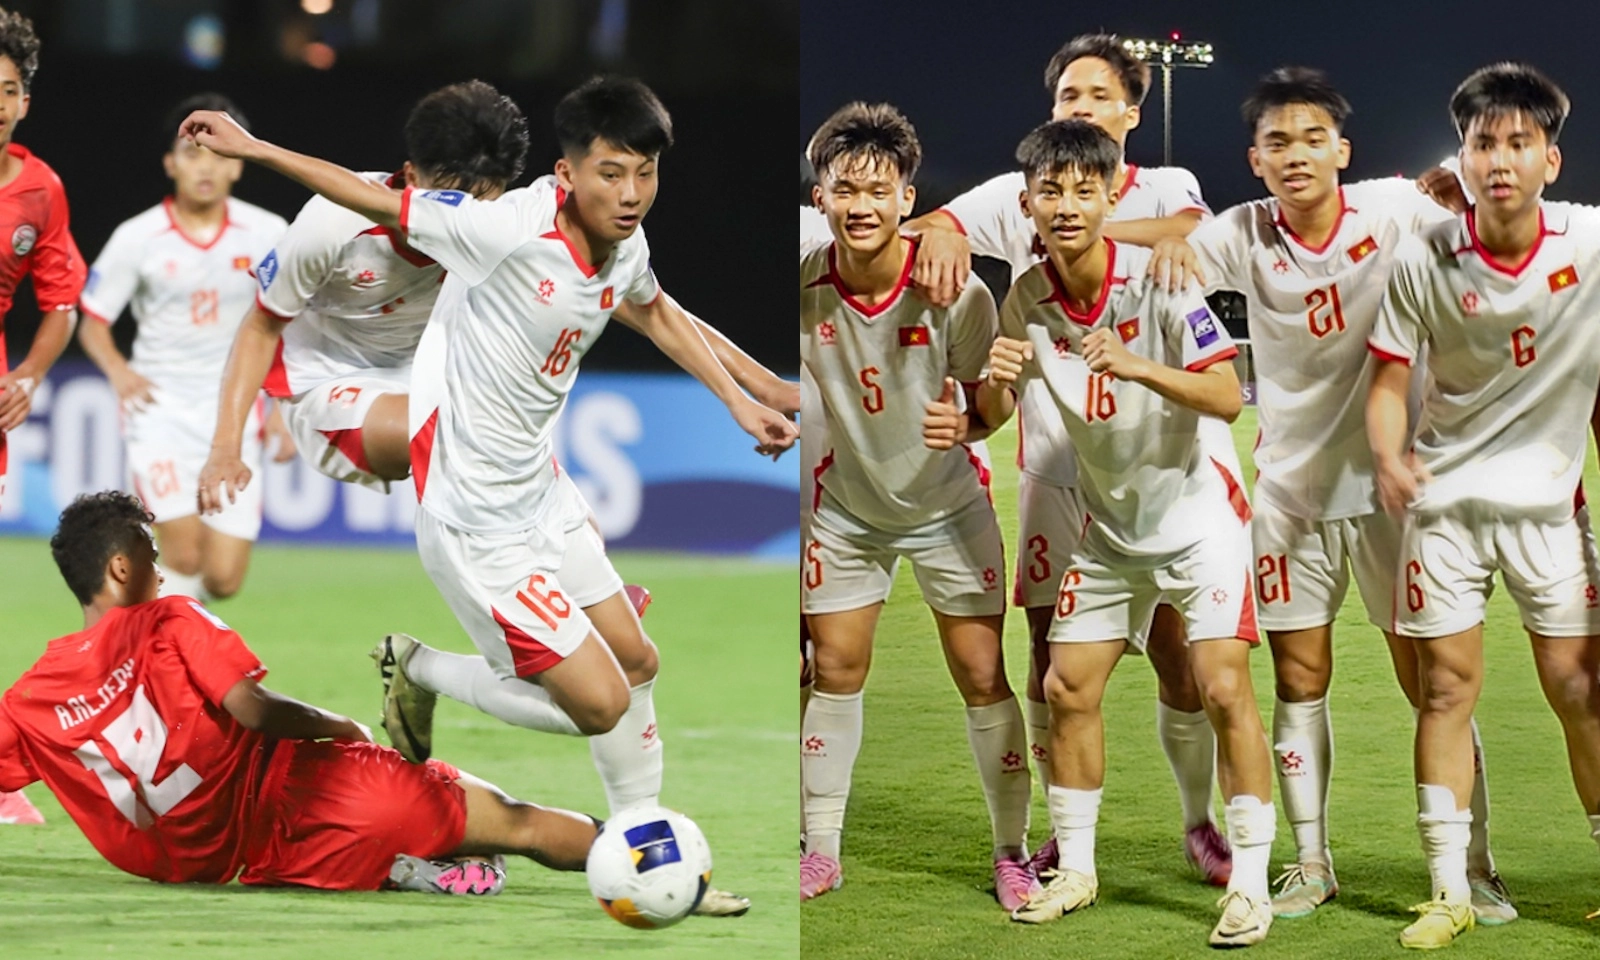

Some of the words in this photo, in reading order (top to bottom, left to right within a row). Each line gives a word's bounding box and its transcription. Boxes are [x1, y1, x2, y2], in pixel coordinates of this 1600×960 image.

[1304, 284, 1347, 340] 21
[541, 327, 583, 378] 16
[1511, 325, 1536, 369] 6
[860, 366, 884, 416] 5
[1085, 370, 1118, 423] 16
[1028, 534, 1052, 584] 3
[1258, 553, 1292, 606] 21
[515, 574, 571, 633] 16
[1406, 559, 1425, 614] 6
[72, 683, 204, 832] 12
